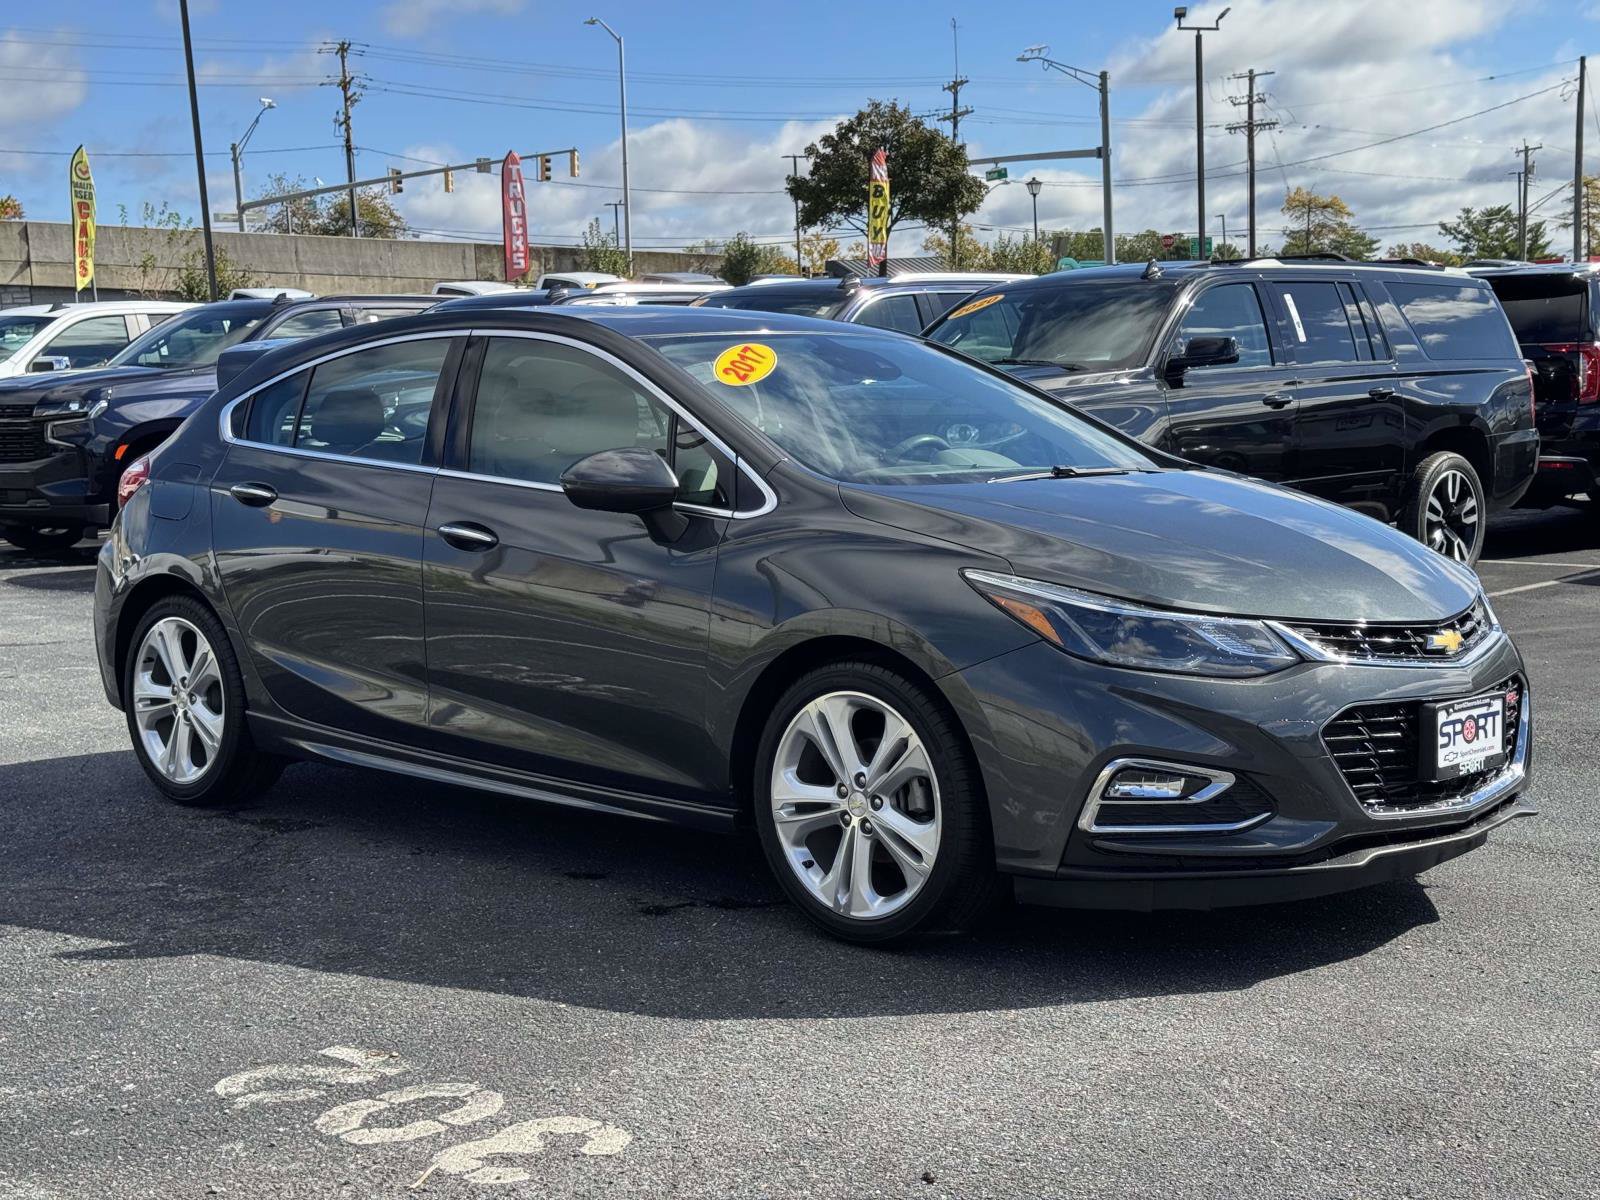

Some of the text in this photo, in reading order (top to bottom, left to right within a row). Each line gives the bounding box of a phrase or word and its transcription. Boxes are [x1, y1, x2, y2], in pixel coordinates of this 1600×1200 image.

[509, 165, 526, 269] TRUCKS
[871, 184, 885, 241] BUY
[77, 201, 90, 277] CARS
[723, 346, 767, 382] 2017
[1440, 710, 1500, 749] SPORT
[1460, 758, 1485, 776] SPORT
